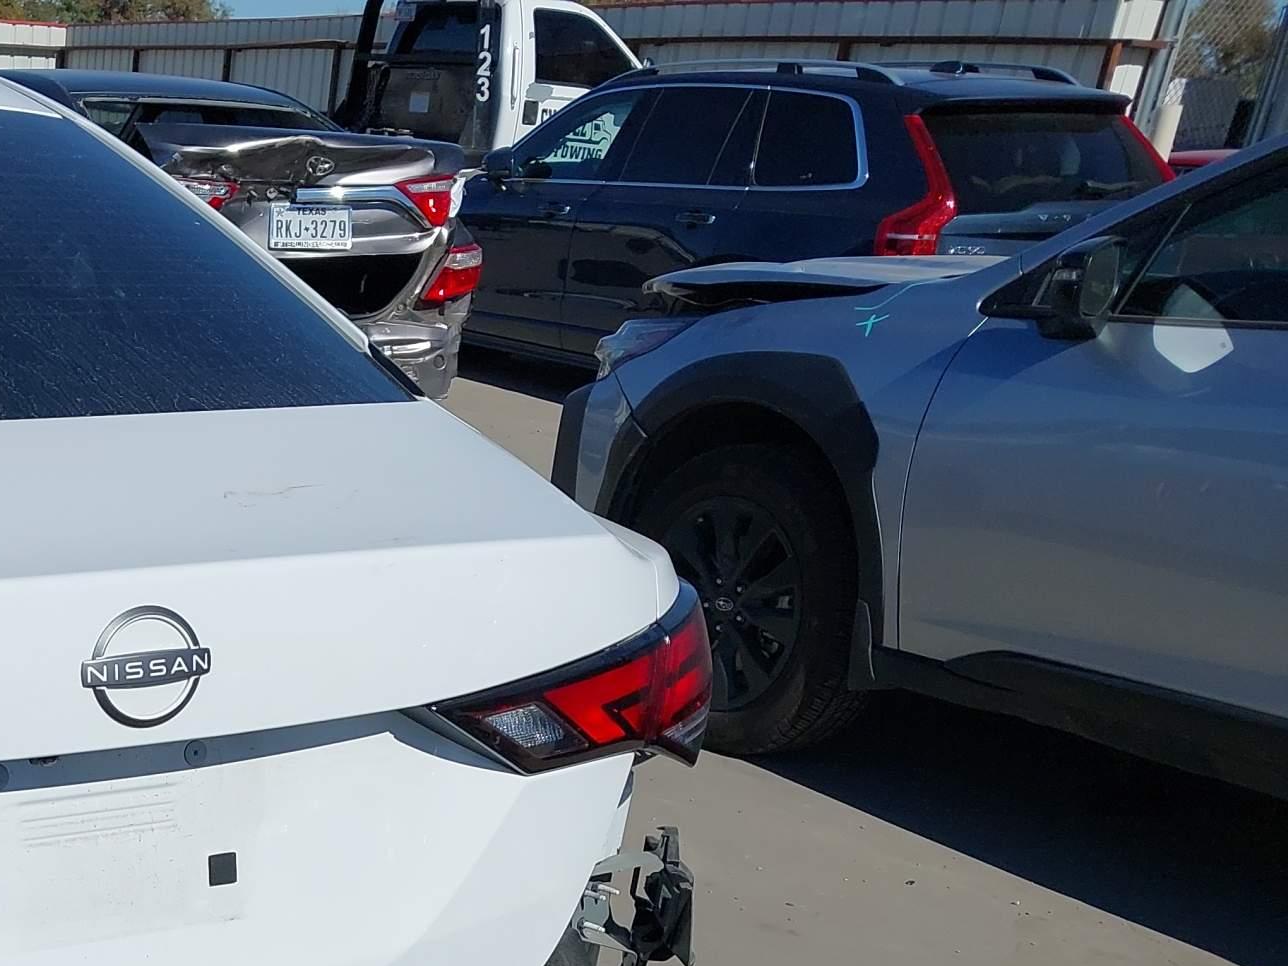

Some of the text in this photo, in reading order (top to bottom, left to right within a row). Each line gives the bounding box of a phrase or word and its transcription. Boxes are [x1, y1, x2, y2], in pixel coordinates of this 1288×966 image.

[475, 24, 492, 102] 123
[297, 208, 327, 216] TEXAS
[275, 219, 347, 239] RKJ 3279
[83, 647, 210, 687] NISSAN
